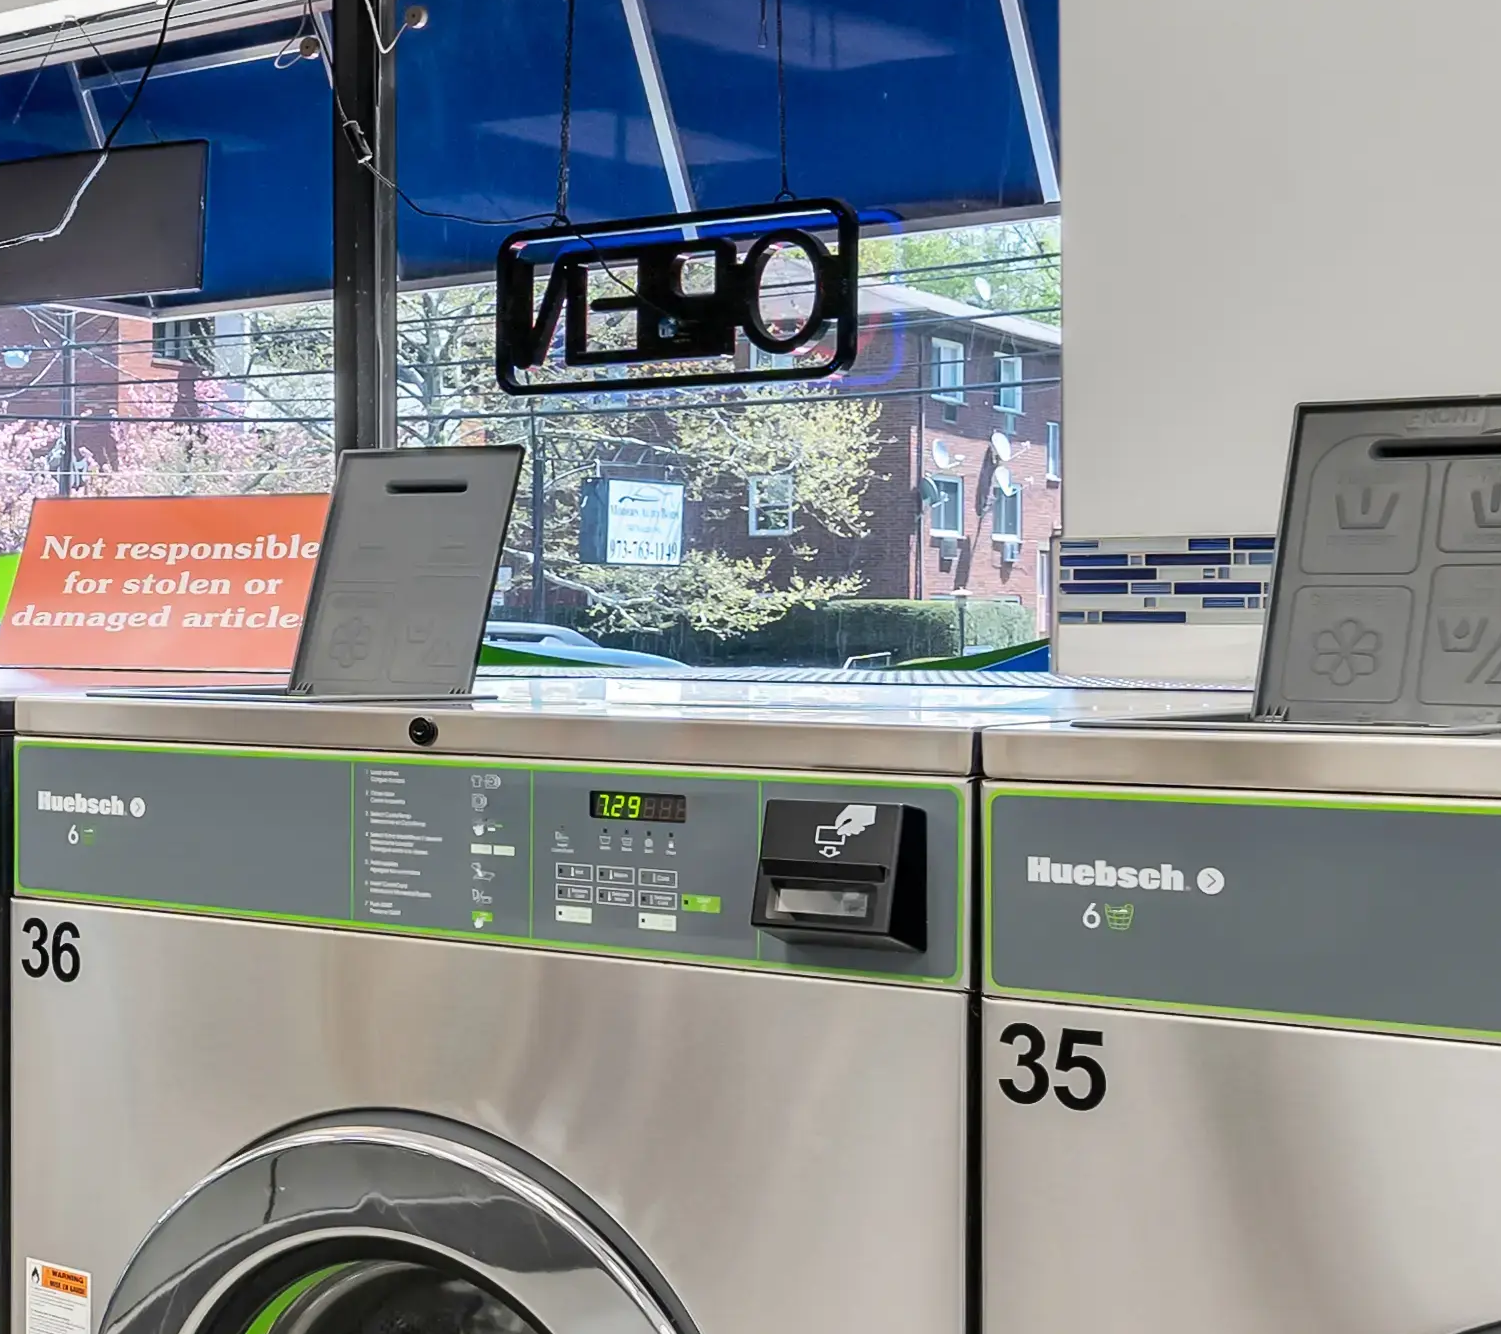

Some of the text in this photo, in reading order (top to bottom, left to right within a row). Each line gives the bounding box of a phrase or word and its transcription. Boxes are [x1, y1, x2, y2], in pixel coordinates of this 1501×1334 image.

[40, 534, 320, 565] Not responsible
[63, 571, 284, 595] for stolen or
[11, 604, 303, 632] damaged article
[38, 790, 125, 816] Huebsch
[600, 794, 641, 818] 7.29
[68, 824, 80, 845] 6
[1027, 856, 1186, 891] Huebsch
[1082, 902, 1101, 929] 6
[21, 917, 81, 983] 36
[998, 1022, 1107, 1111] 35
